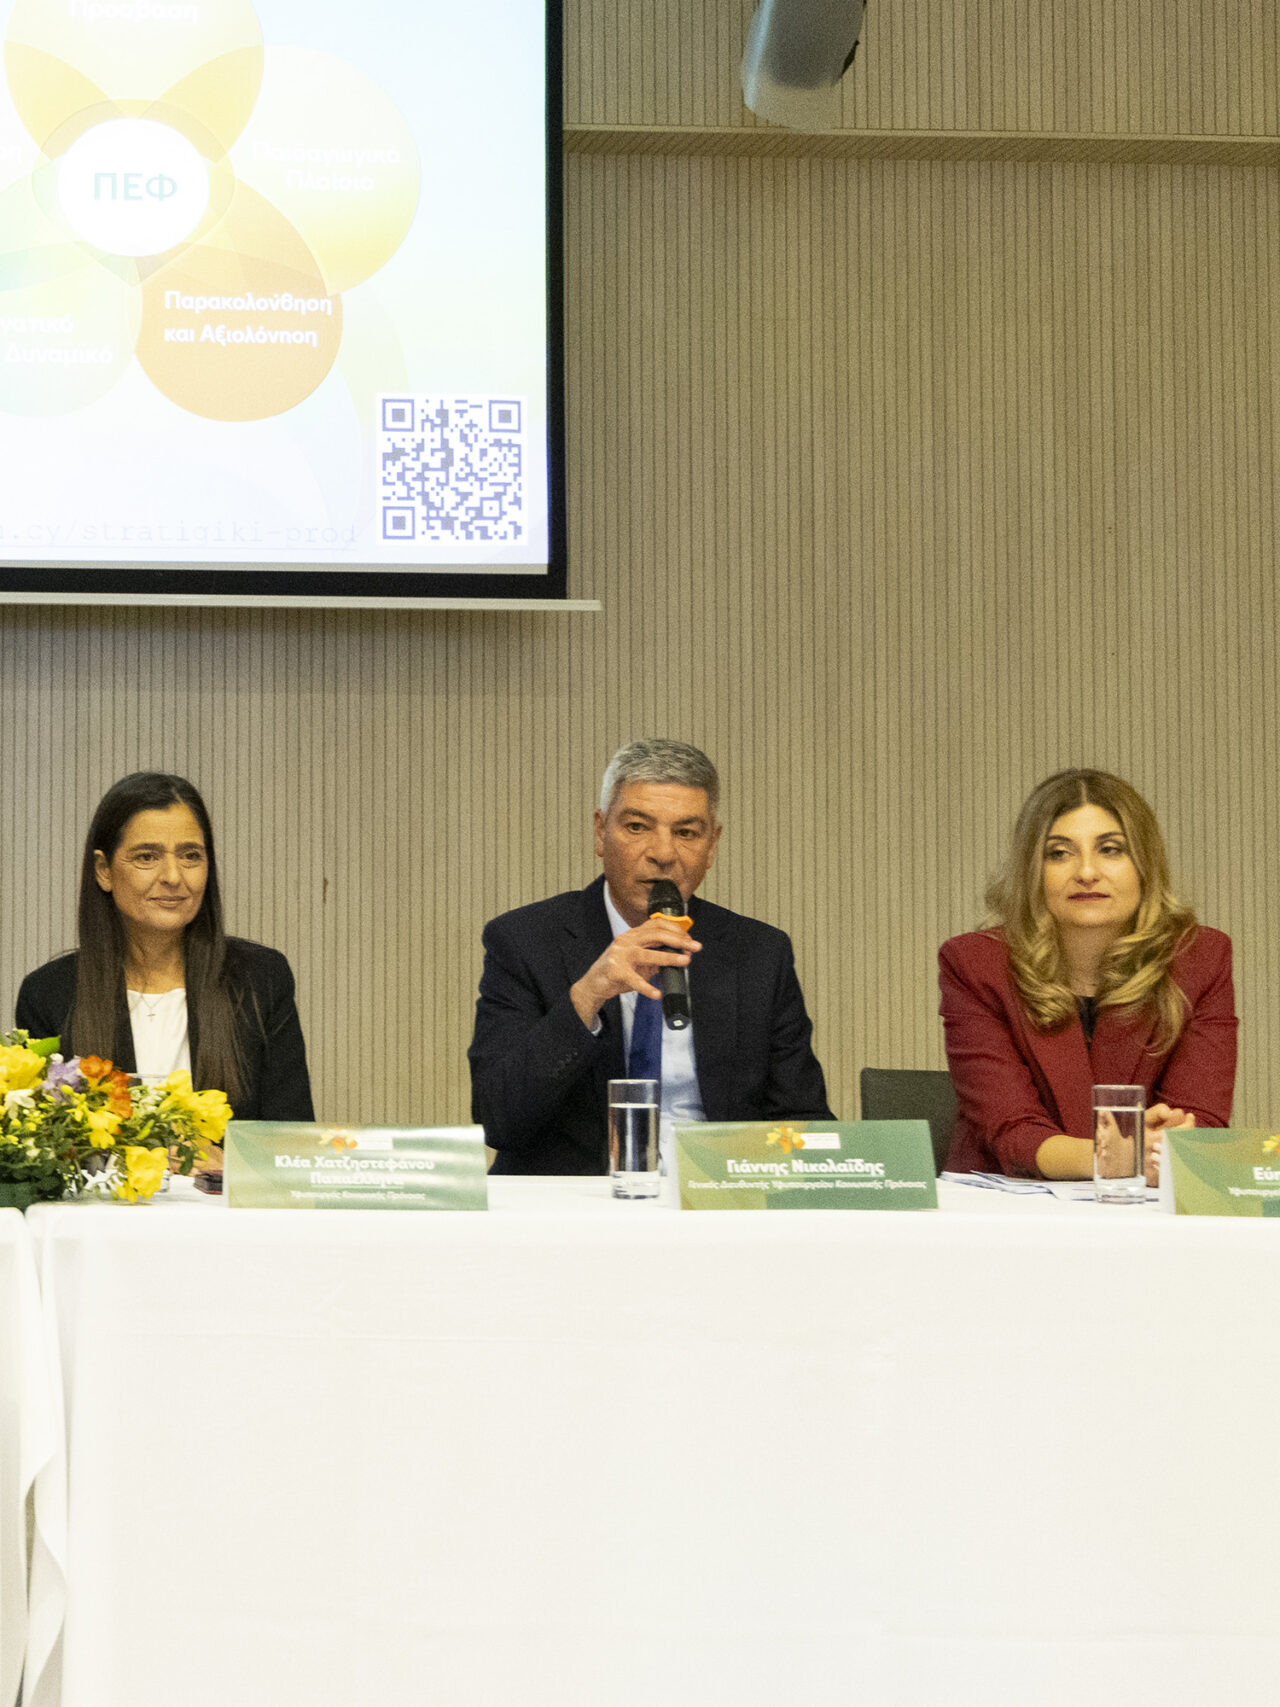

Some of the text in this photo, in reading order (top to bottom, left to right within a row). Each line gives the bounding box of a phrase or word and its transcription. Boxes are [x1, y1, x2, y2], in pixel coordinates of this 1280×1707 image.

[94, 172, 178, 202] ΠΕΦ
[163, 289, 333, 316] Παρακολούθηση
[163, 327, 195, 343] και
[726, 1159, 789, 1177] Γιάννης
